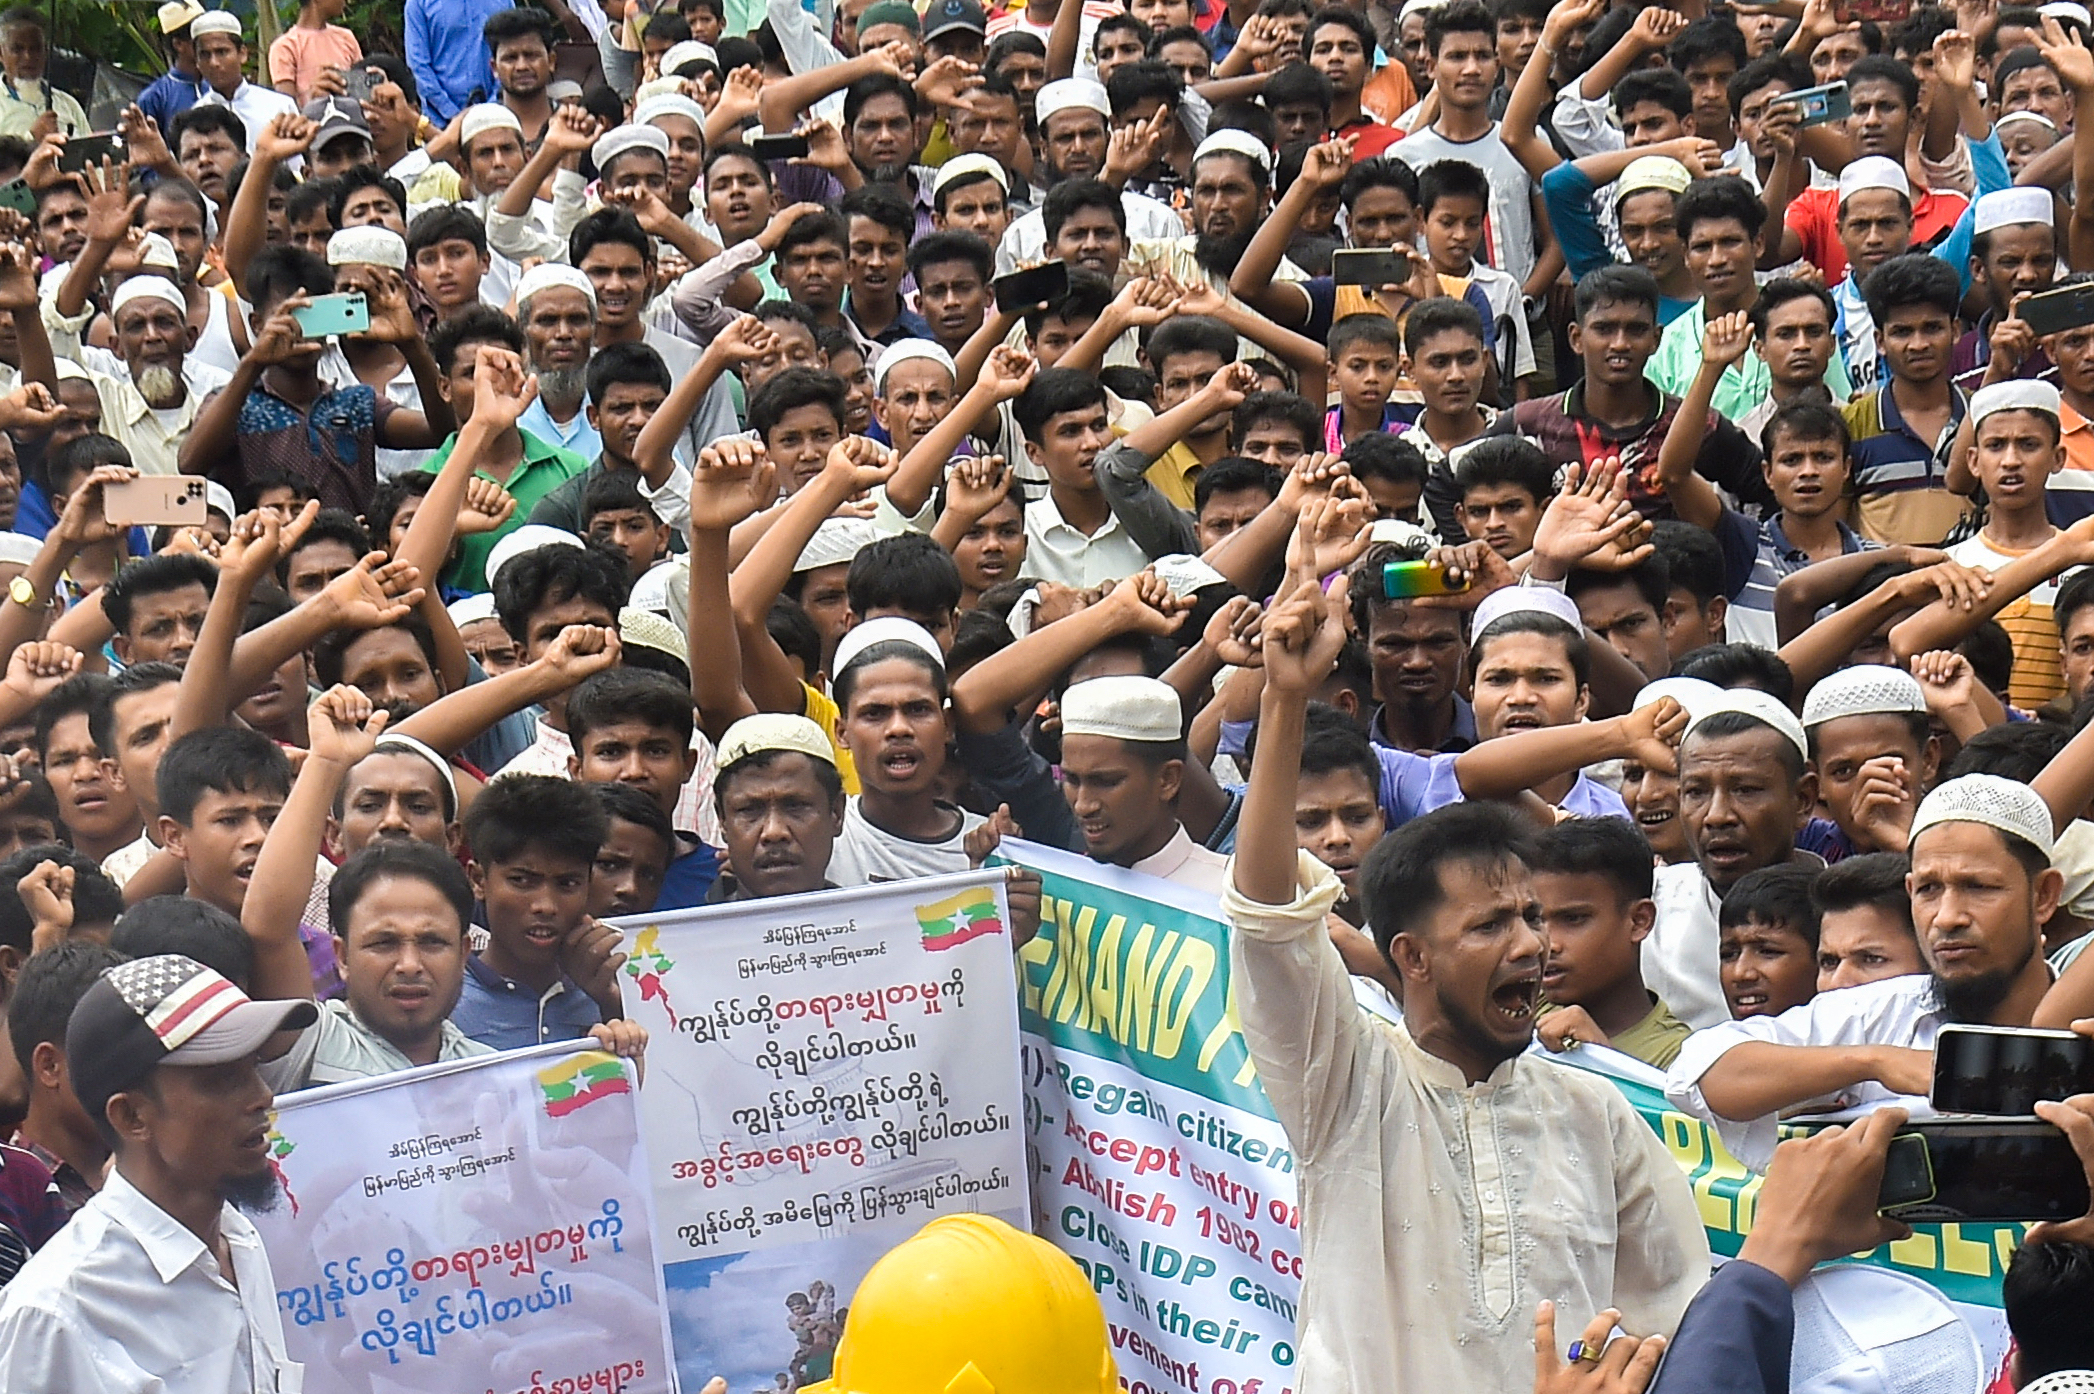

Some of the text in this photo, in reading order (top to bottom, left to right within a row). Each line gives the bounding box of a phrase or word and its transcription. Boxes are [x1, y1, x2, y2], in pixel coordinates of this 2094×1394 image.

[1016, 895, 1216, 1060] EMAND
[1055, 1060, 1169, 1127] Regain
[1064, 1109, 1180, 1177] Accept
[1190, 1163, 1259, 1220] entry
[1061, 1206, 1130, 1263] Close
[1140, 1241, 1216, 1285] IDP
[1229, 1276, 1297, 1323] cam
[1196, 1206, 1263, 1263] 1982
[1131, 1282, 1150, 1320] in
[1156, 1299, 1260, 1355] their
